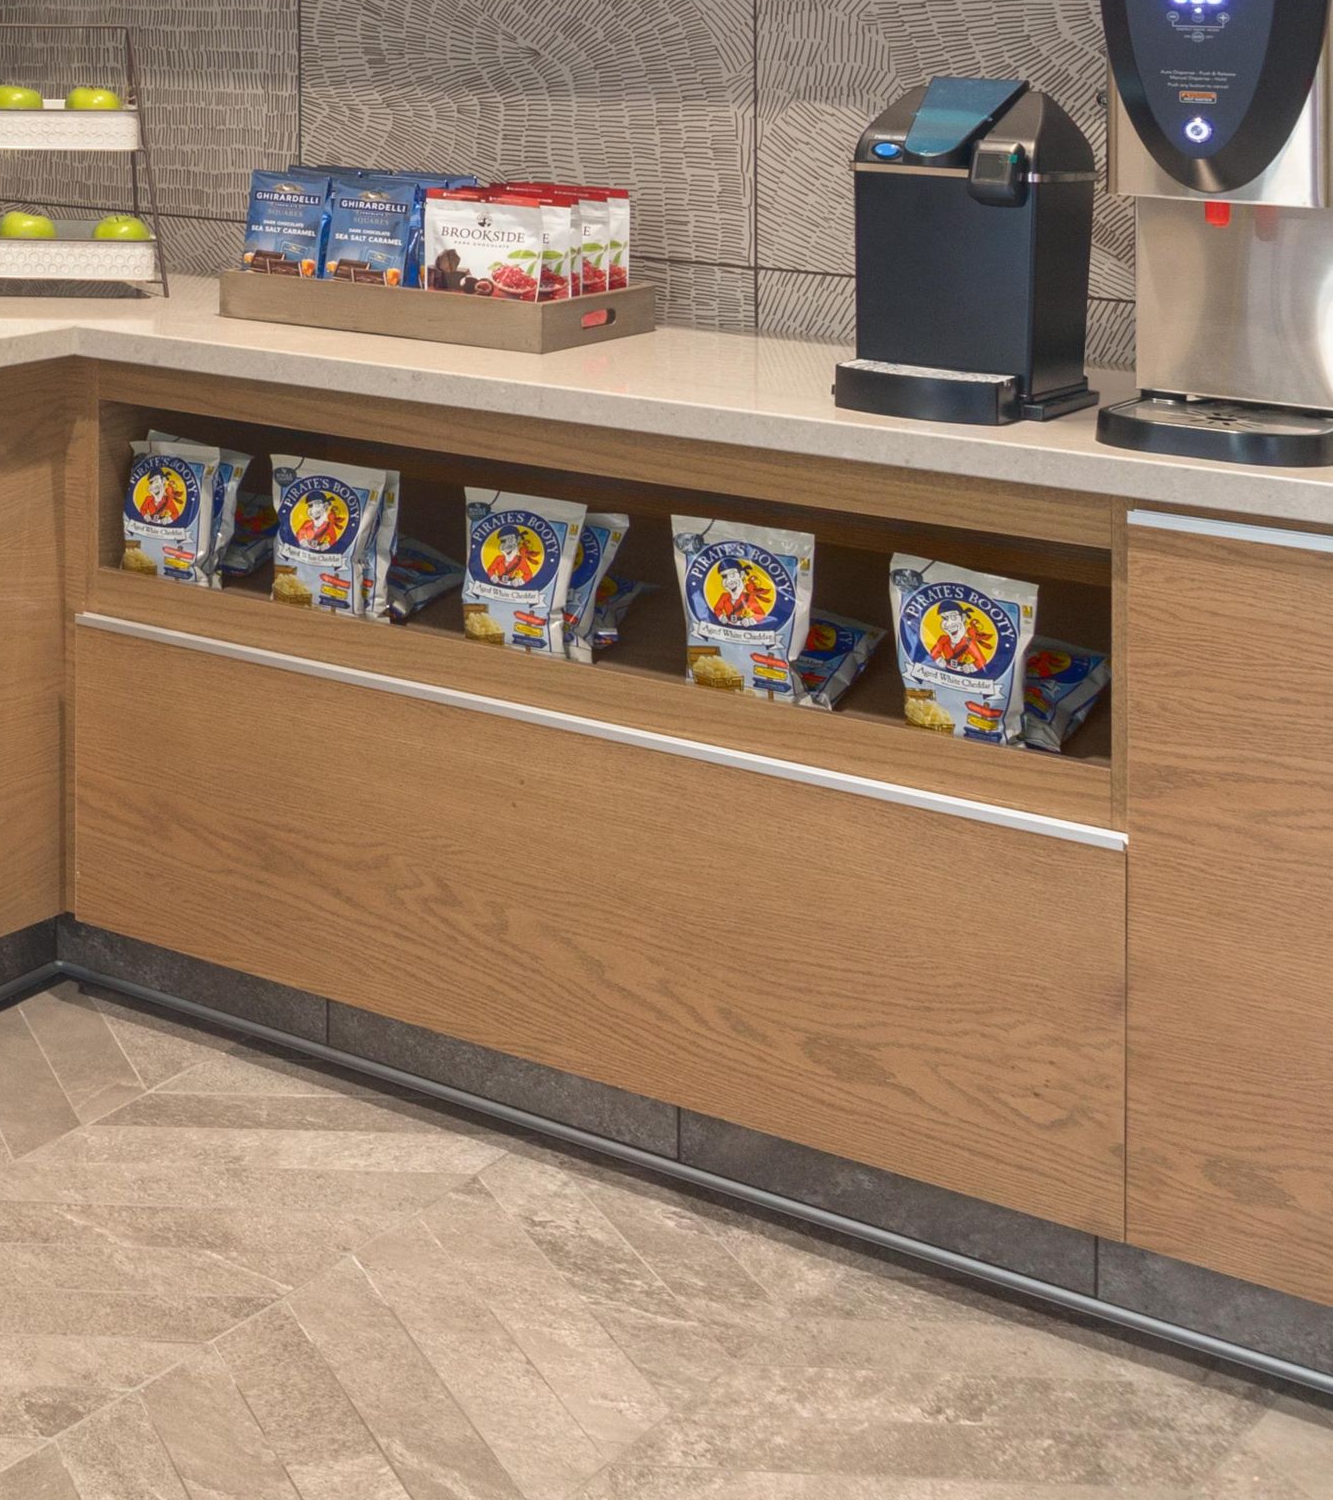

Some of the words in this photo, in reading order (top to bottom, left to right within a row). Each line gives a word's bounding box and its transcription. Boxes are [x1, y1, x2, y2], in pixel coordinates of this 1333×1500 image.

[256, 192, 319, 205] GHIRARDELLI
[341, 199, 407, 213] GHIRARDELLI
[282, 228, 316, 238] CARAMEL
[368, 236, 403, 246] CARAMEL
[441, 226, 526, 244] BROOKSIDE
[130, 456, 171, 485] PIRATE'S
[169, 458, 198, 493] BOOTY
[286, 475, 331, 508] PIRATE'S
[332, 479, 360, 520] BOOTY
[473, 512, 527, 542] PIRATE'S
[528, 515, 559, 555] BOOTY
[691, 543, 745, 579] PIRATE'S
[752, 548, 793, 595] BOOTY
[905, 585, 965, 618] PIRATE'S
[968, 591, 1015, 640] BOOTY
[917, 666, 939, 679] Aged
[962, 678, 991, 690] Cheddar
